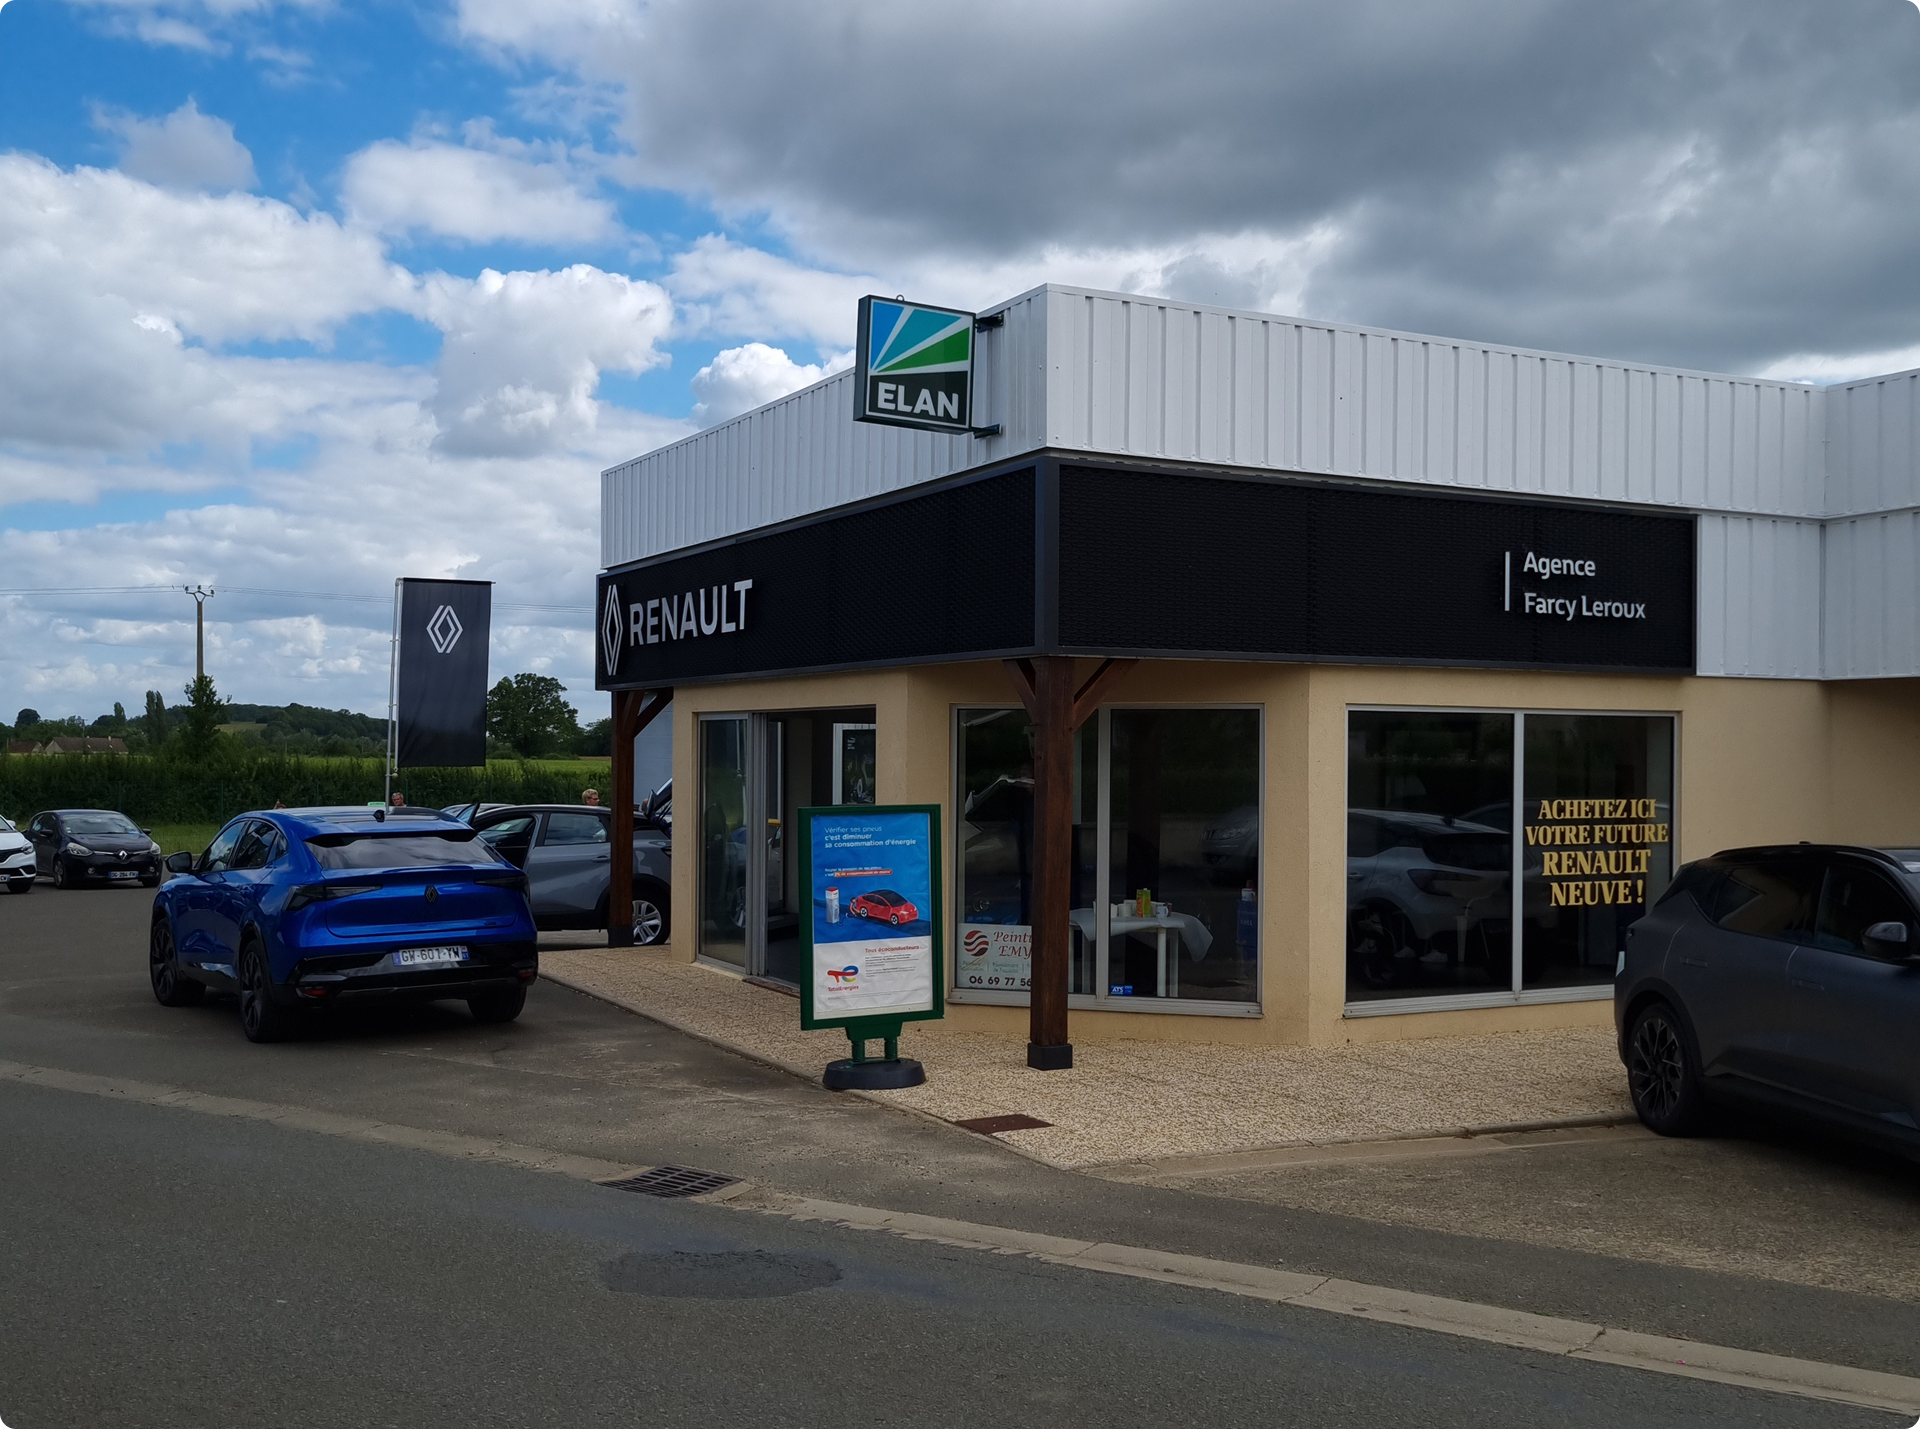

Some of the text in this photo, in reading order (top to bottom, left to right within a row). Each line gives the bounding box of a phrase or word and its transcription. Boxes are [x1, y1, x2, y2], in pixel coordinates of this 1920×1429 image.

[877, 381, 959, 419] ELAN
[1523, 551, 1596, 580] Agence
[629, 579, 753, 647] RENAULT
[1524, 592, 1646, 621] Farcy Leroux
[1538, 799, 1657, 820] ACHETEZ ICI
[834, 840, 884, 848] consommation
[1525, 823, 1669, 846] VOTRE FUTURE
[1542, 850, 1651, 876] RENAULT
[1550, 879, 1644, 907] NEUVE !
[969, 976, 1031, 986] 06 69 77 56
